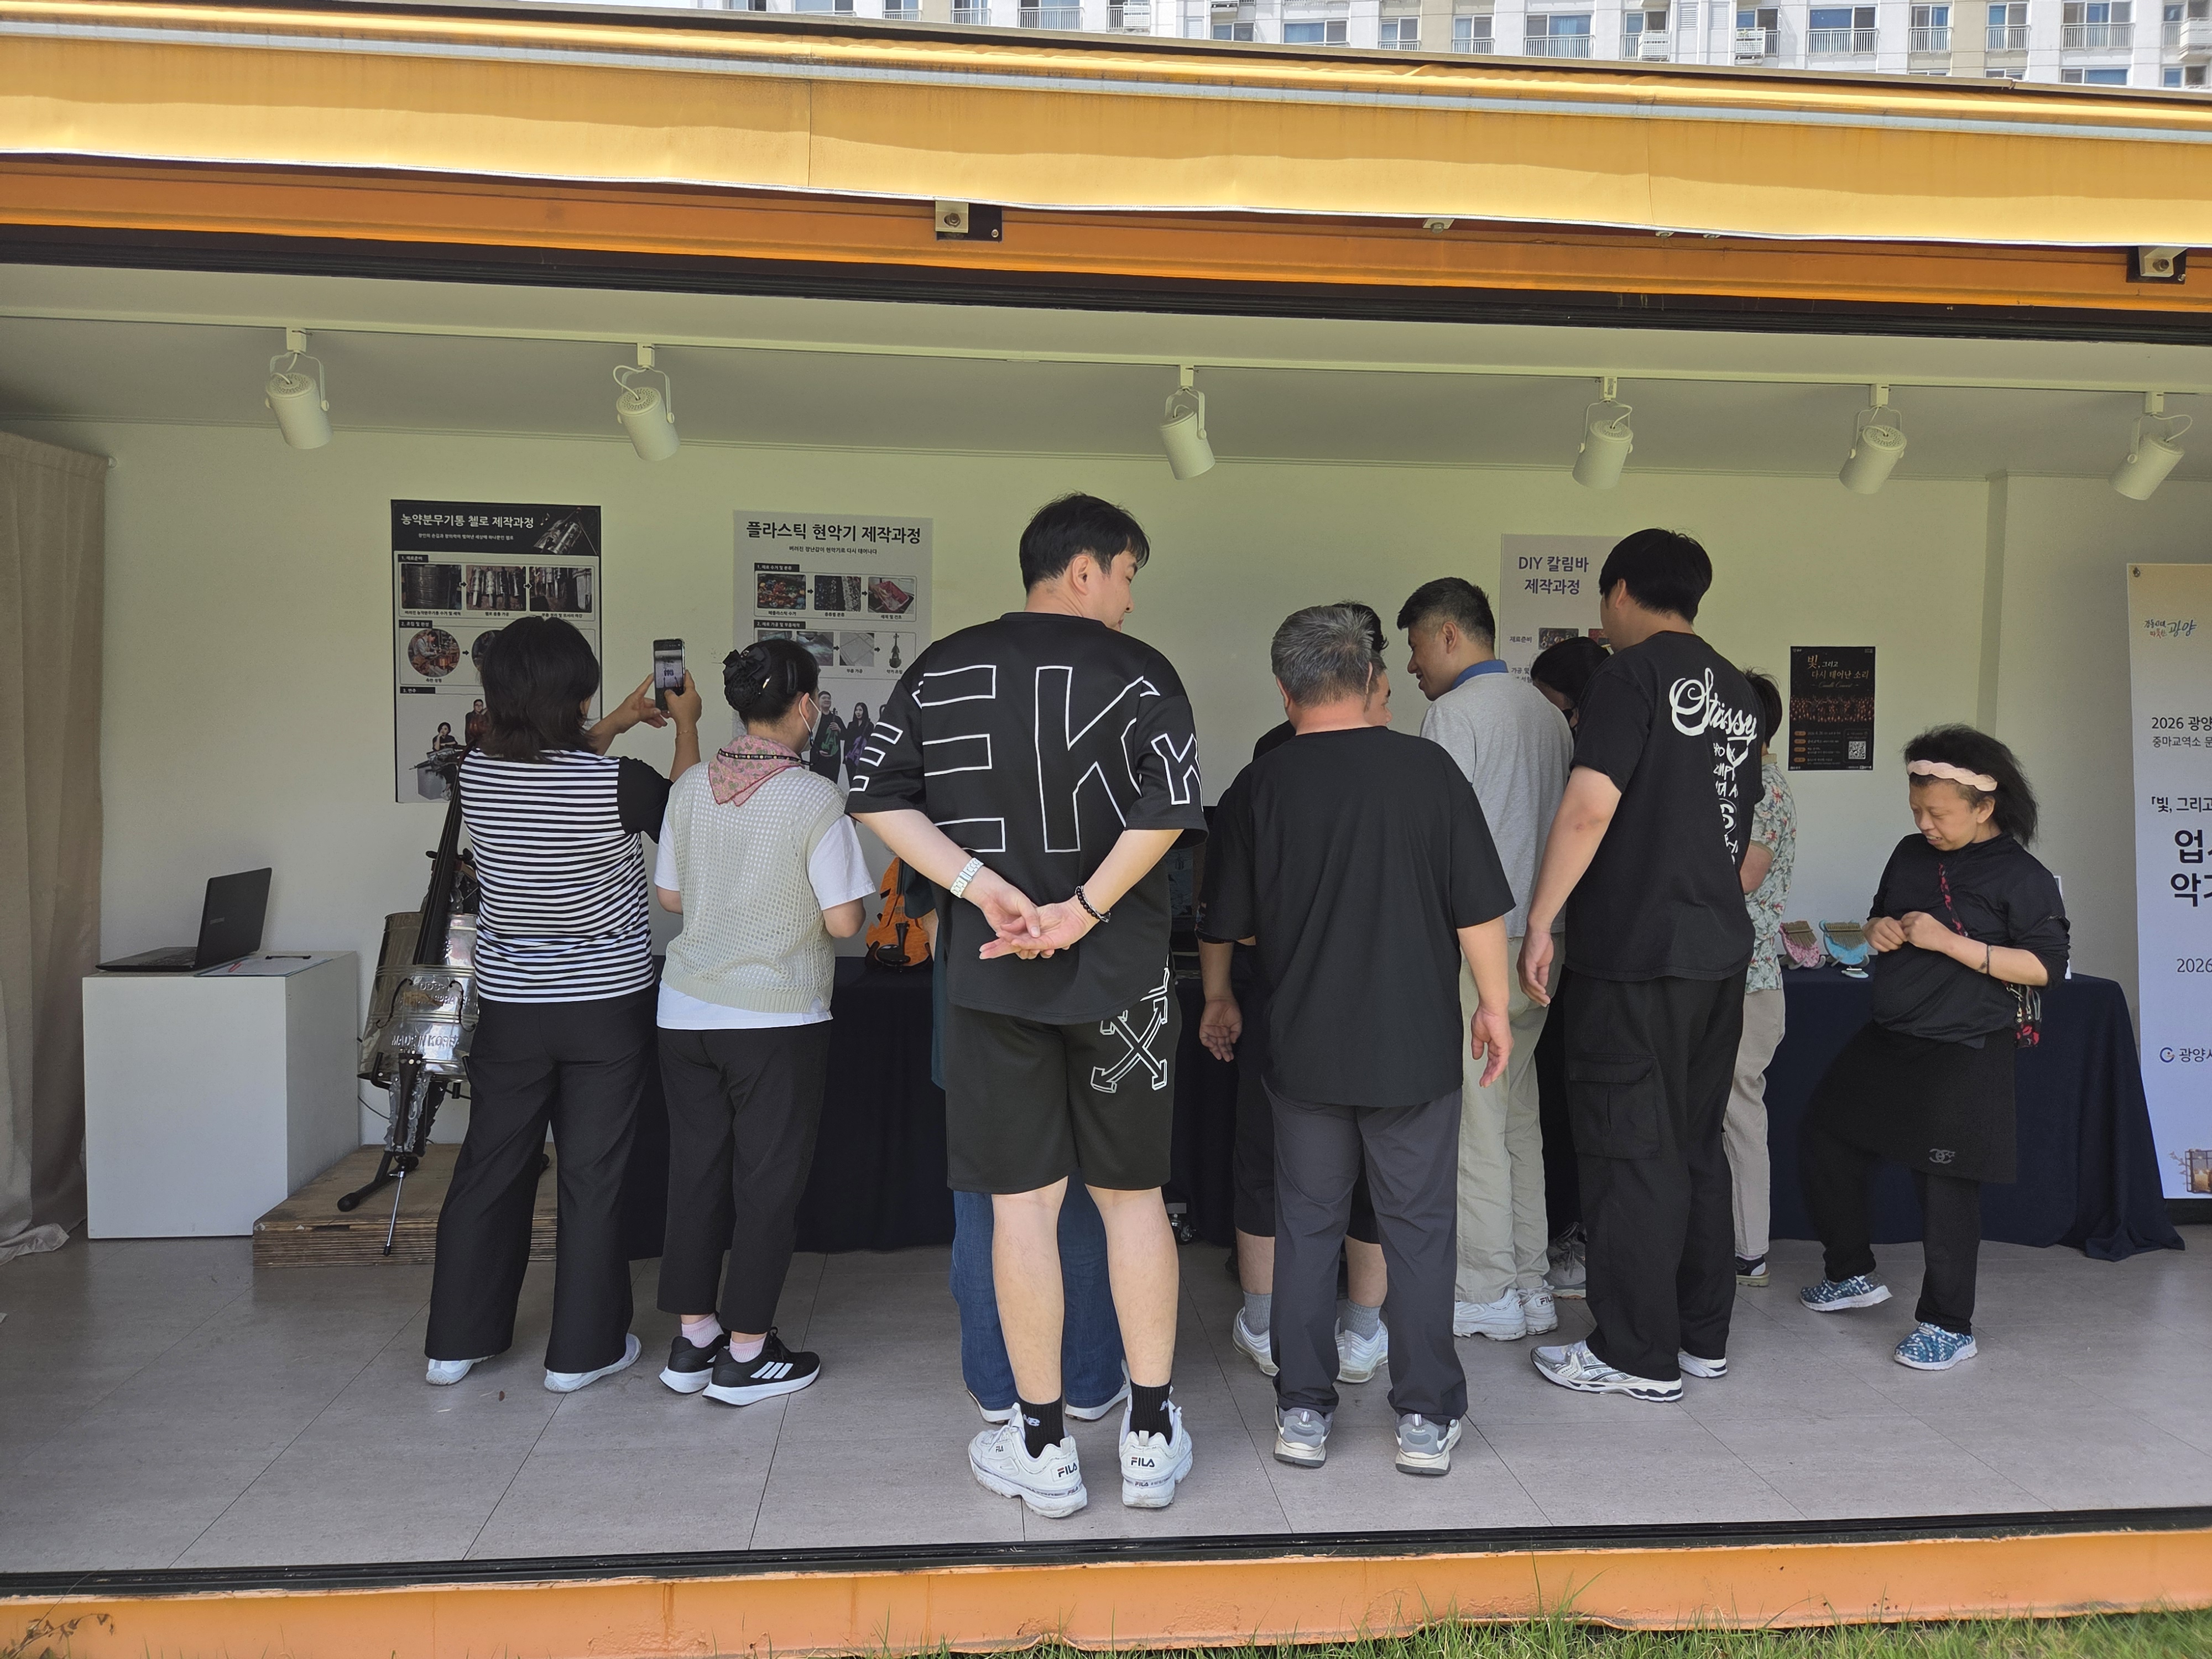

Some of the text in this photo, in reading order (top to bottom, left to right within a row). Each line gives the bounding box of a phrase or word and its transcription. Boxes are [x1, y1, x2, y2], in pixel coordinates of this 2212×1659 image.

[401, 514, 534, 529] 농약분무기통 첼로 제작과정
[747, 521, 921, 544] 플라스틱 현악기 제작과정
[1519, 556, 1589, 572] DIY 칼림바
[1524, 578, 1580, 595] 제작과정
[2167, 619, 2197, 637] 광양
[1812, 670, 1869, 680] 다시 태어난 소리
[2152, 717, 2184, 729] 2026
[2152, 736, 2201, 748] 중마교역소
[2176, 797, 2212, 813] 그리고
[2174, 830, 2212, 864] 업
[2177, 958, 2212, 973] 2026
[995, 1445, 1004, 1453] FILA
[1057, 1462, 1078, 1478] FILA
[1131, 1457, 1155, 1468] FILA
[1067, 1486, 1078, 1495] FILA
